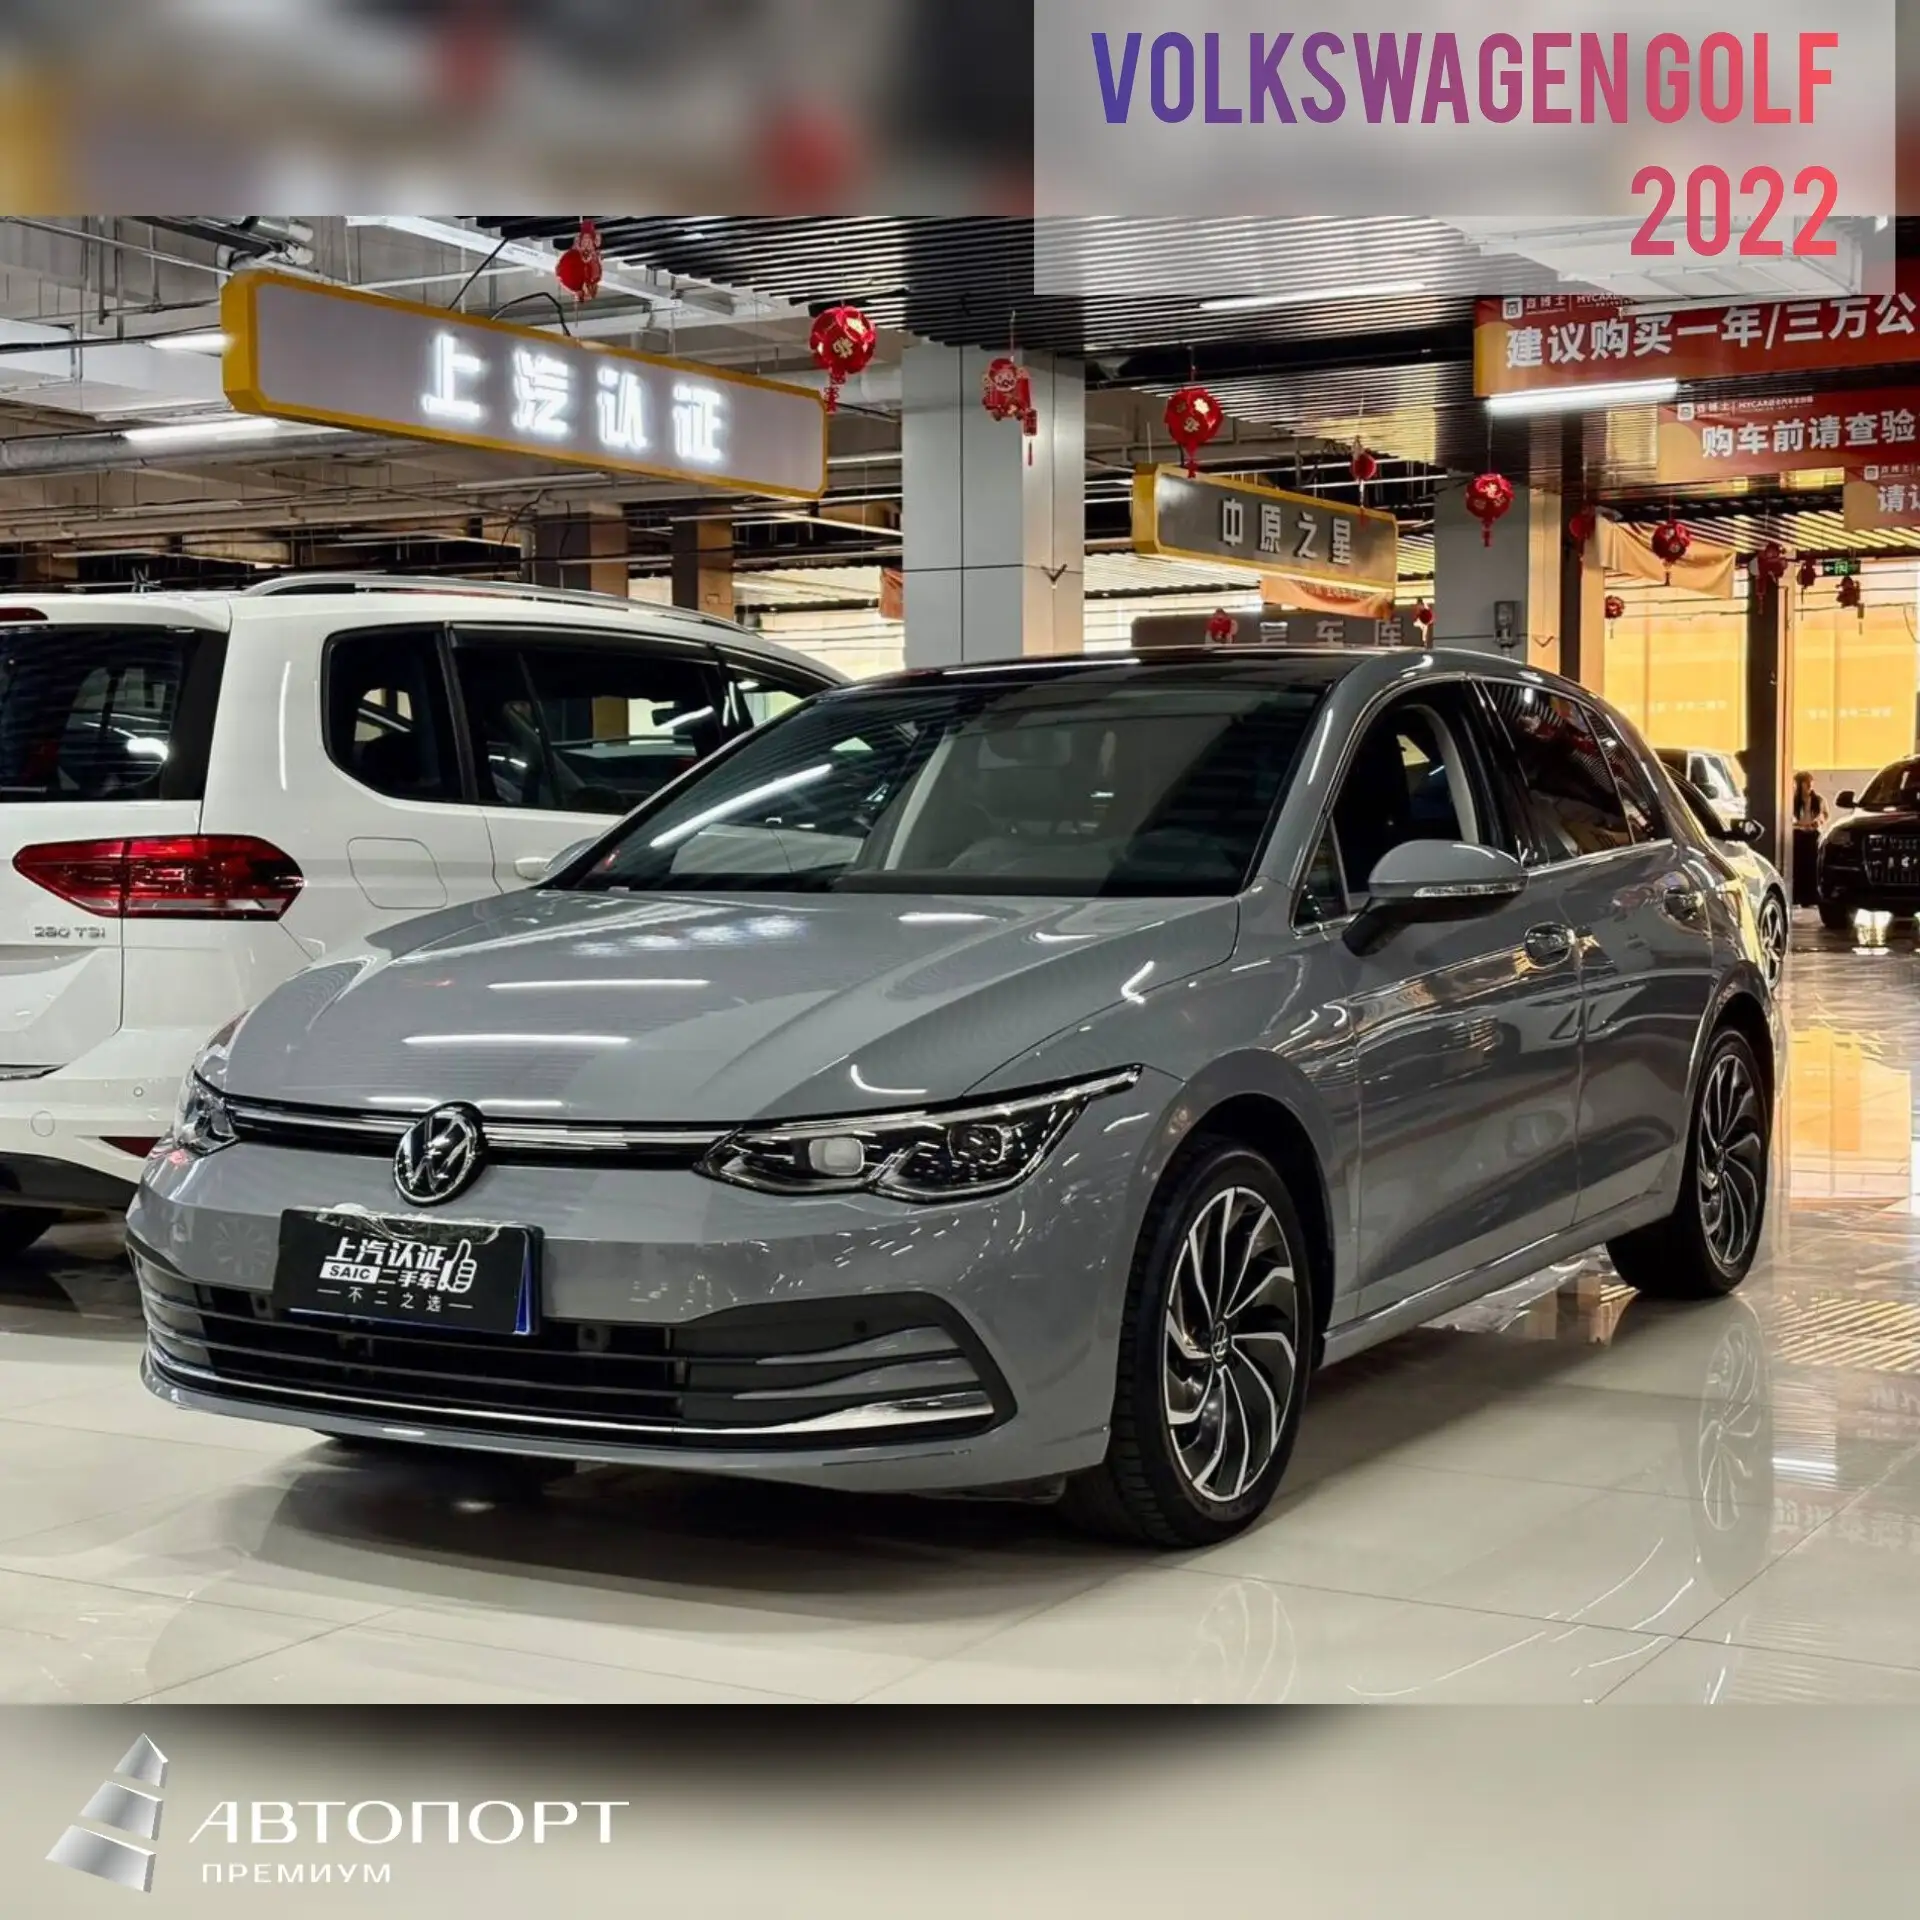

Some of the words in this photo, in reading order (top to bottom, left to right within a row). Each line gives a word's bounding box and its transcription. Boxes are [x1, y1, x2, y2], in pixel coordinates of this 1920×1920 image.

[1506, 292, 1917, 370] 建议购买一年/三万公
[421, 332, 728, 463] 上汽认证
[1702, 408, 1916, 459] 购车前请查验
[1221, 498, 1351, 565] 中原之星
[325, 1236, 448, 1272] 上汽认证
[329, 1264, 371, 1280] SAIC
[378, 1267, 440, 1290] 二手车
[349, 1286, 442, 1313] 不二之选
